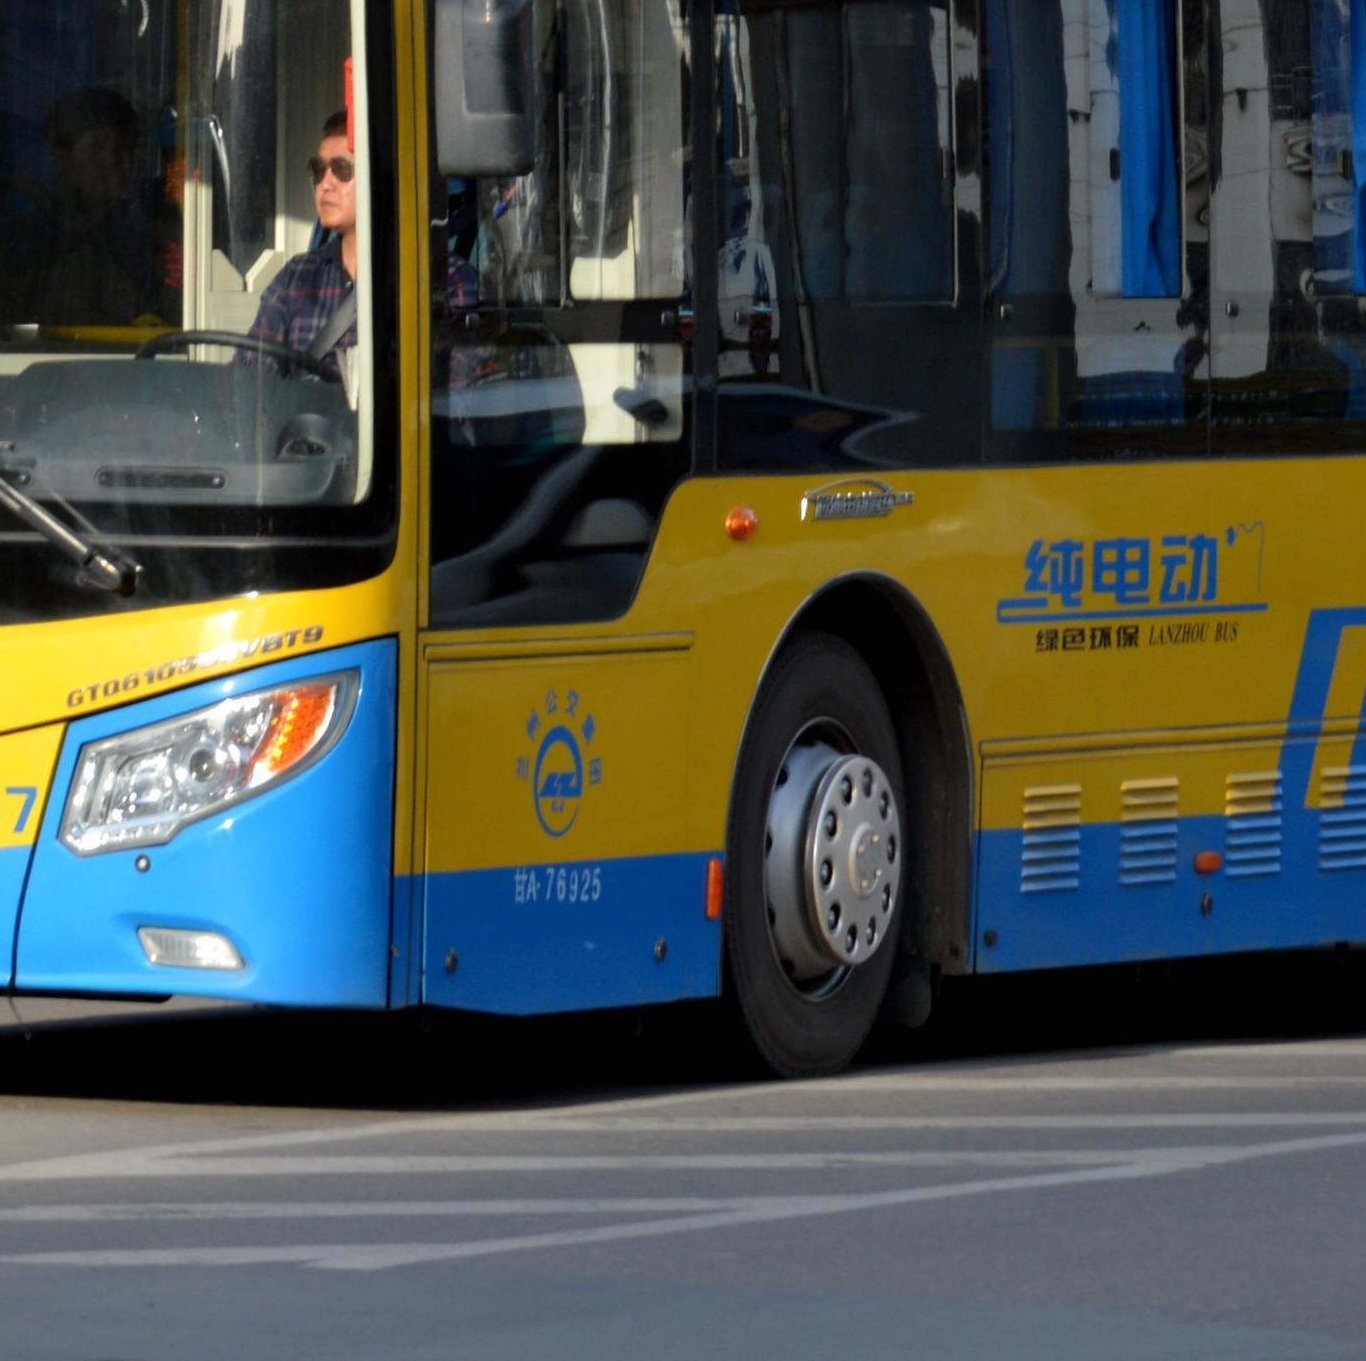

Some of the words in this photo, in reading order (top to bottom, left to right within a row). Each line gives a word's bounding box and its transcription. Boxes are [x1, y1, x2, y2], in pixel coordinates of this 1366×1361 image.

[1023, 534, 1219, 608] 纯电动
[1035, 624, 1140, 653] 绿色环保
[1148, 623, 1209, 646] LANZHOU
[1214, 621, 1240, 643] BUS
